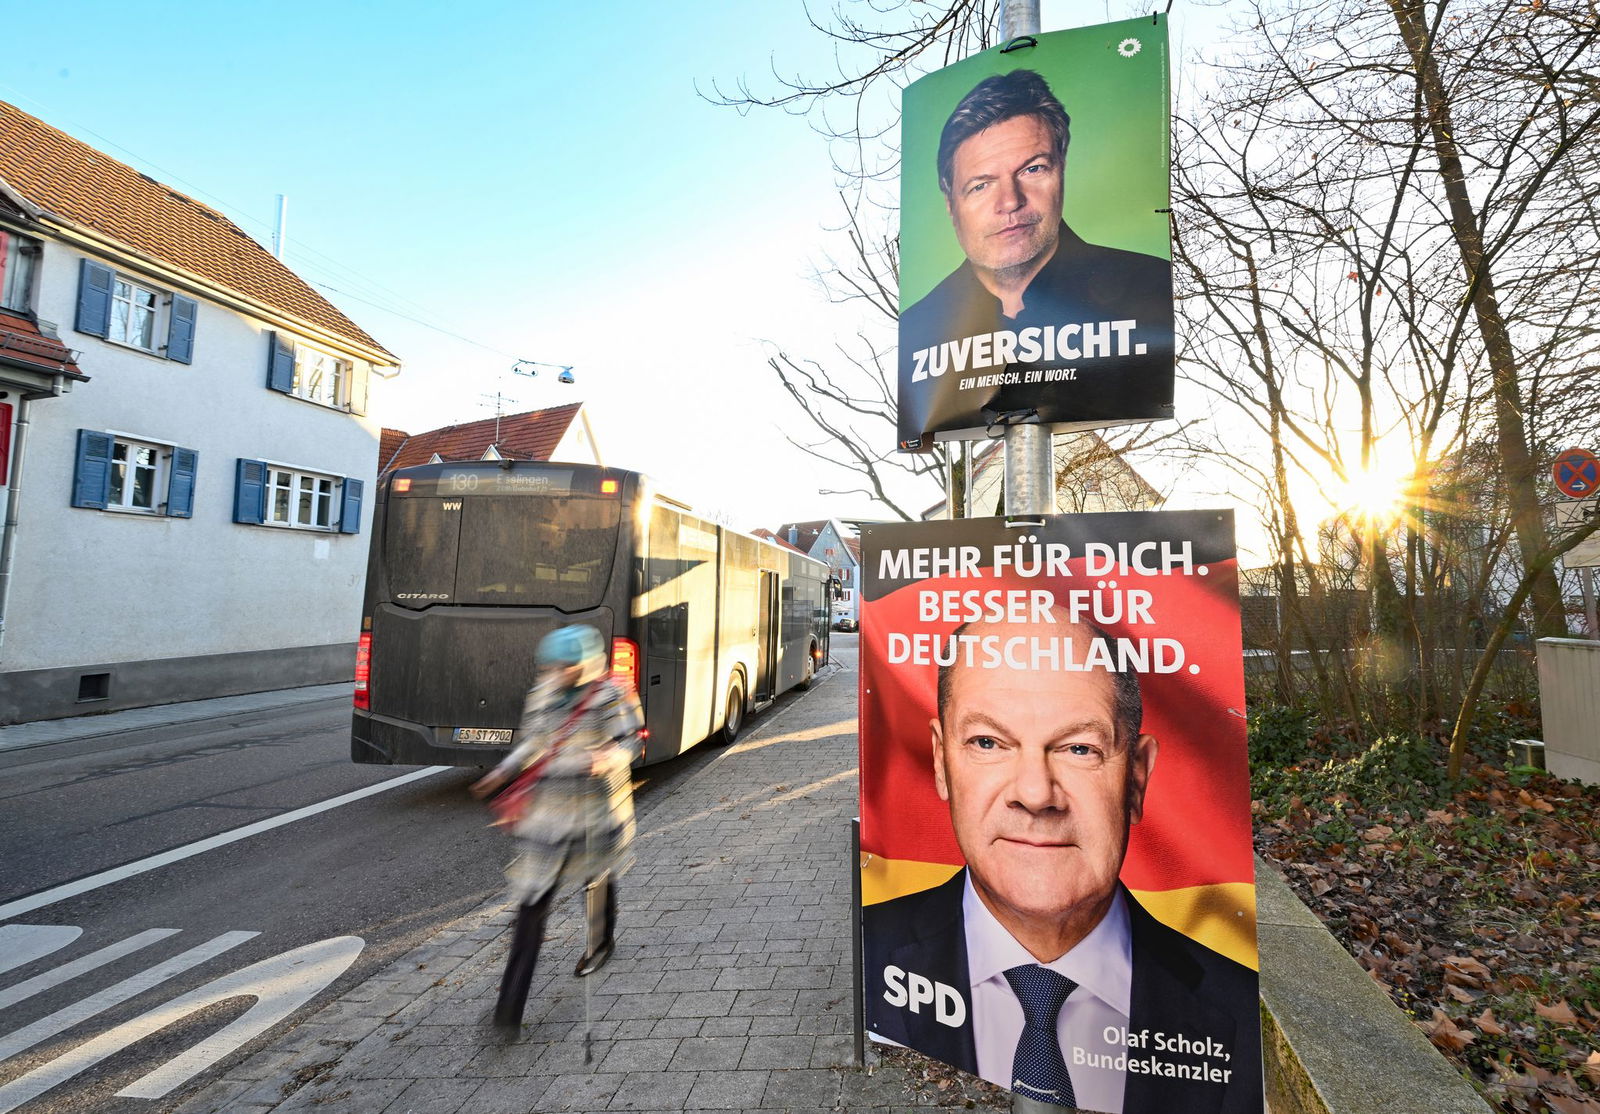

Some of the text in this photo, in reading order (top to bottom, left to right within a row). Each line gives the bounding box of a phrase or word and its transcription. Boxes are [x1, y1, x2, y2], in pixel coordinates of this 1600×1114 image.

[911, 319, 1148, 383] ZUVERSICHT.
[959, 368, 1077, 390] EIN MENSCH. EIN WORT.
[450, 474, 478, 491] 130
[443, 502, 462, 511] WW
[878, 535, 1209, 579] MEHR FÜR DICH.
[919, 580, 1156, 624] BESSER FÜR
[888, 633, 1200, 675] DEUTSCHLAND.
[459, 730, 511, 741] ES ST 7902
[883, 965, 967, 1028] SPD
[1103, 1026, 1231, 1062] Olaf Scholz,
[1073, 1046, 1232, 1084] Bundeskanzler
